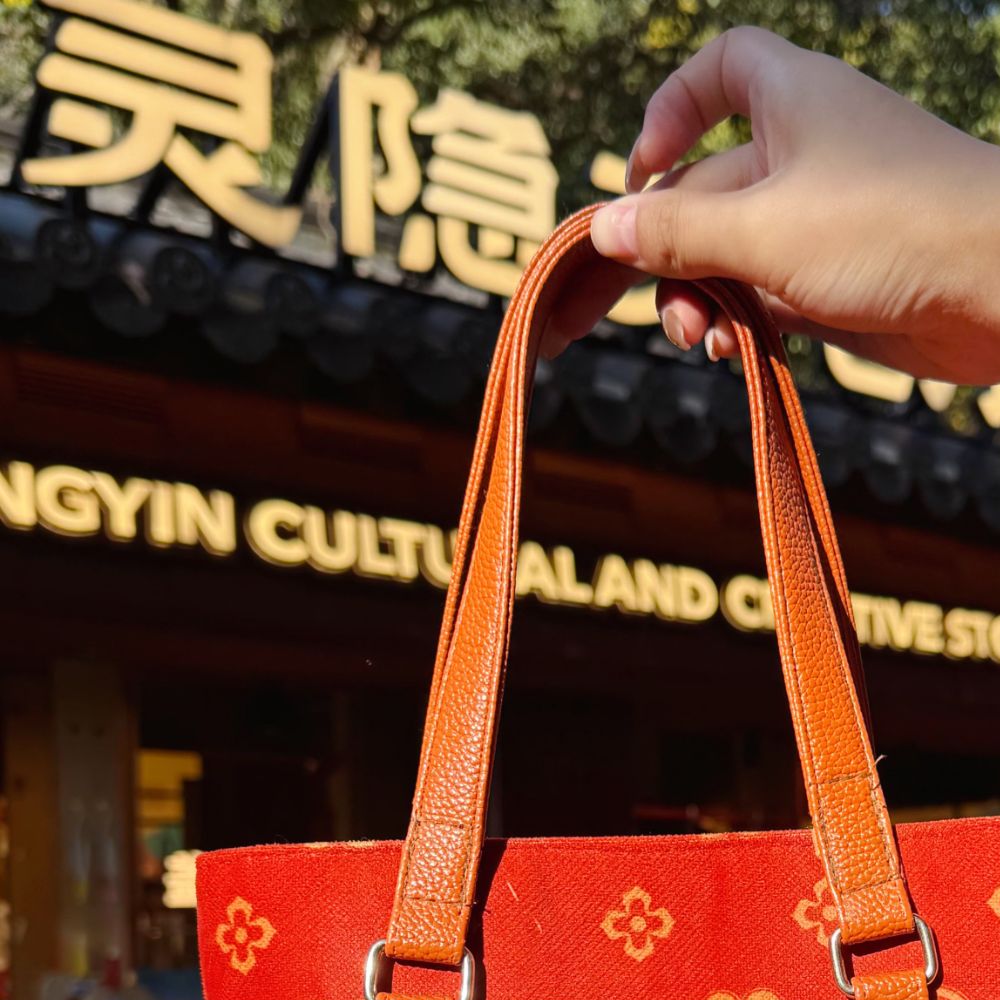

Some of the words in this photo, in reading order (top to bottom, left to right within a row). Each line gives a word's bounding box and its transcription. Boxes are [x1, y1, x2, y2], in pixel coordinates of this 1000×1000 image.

[245, 499, 594, 607] CULTUAL
[590, 552, 718, 622] AND
[722, 572, 943, 655] CTIVE
